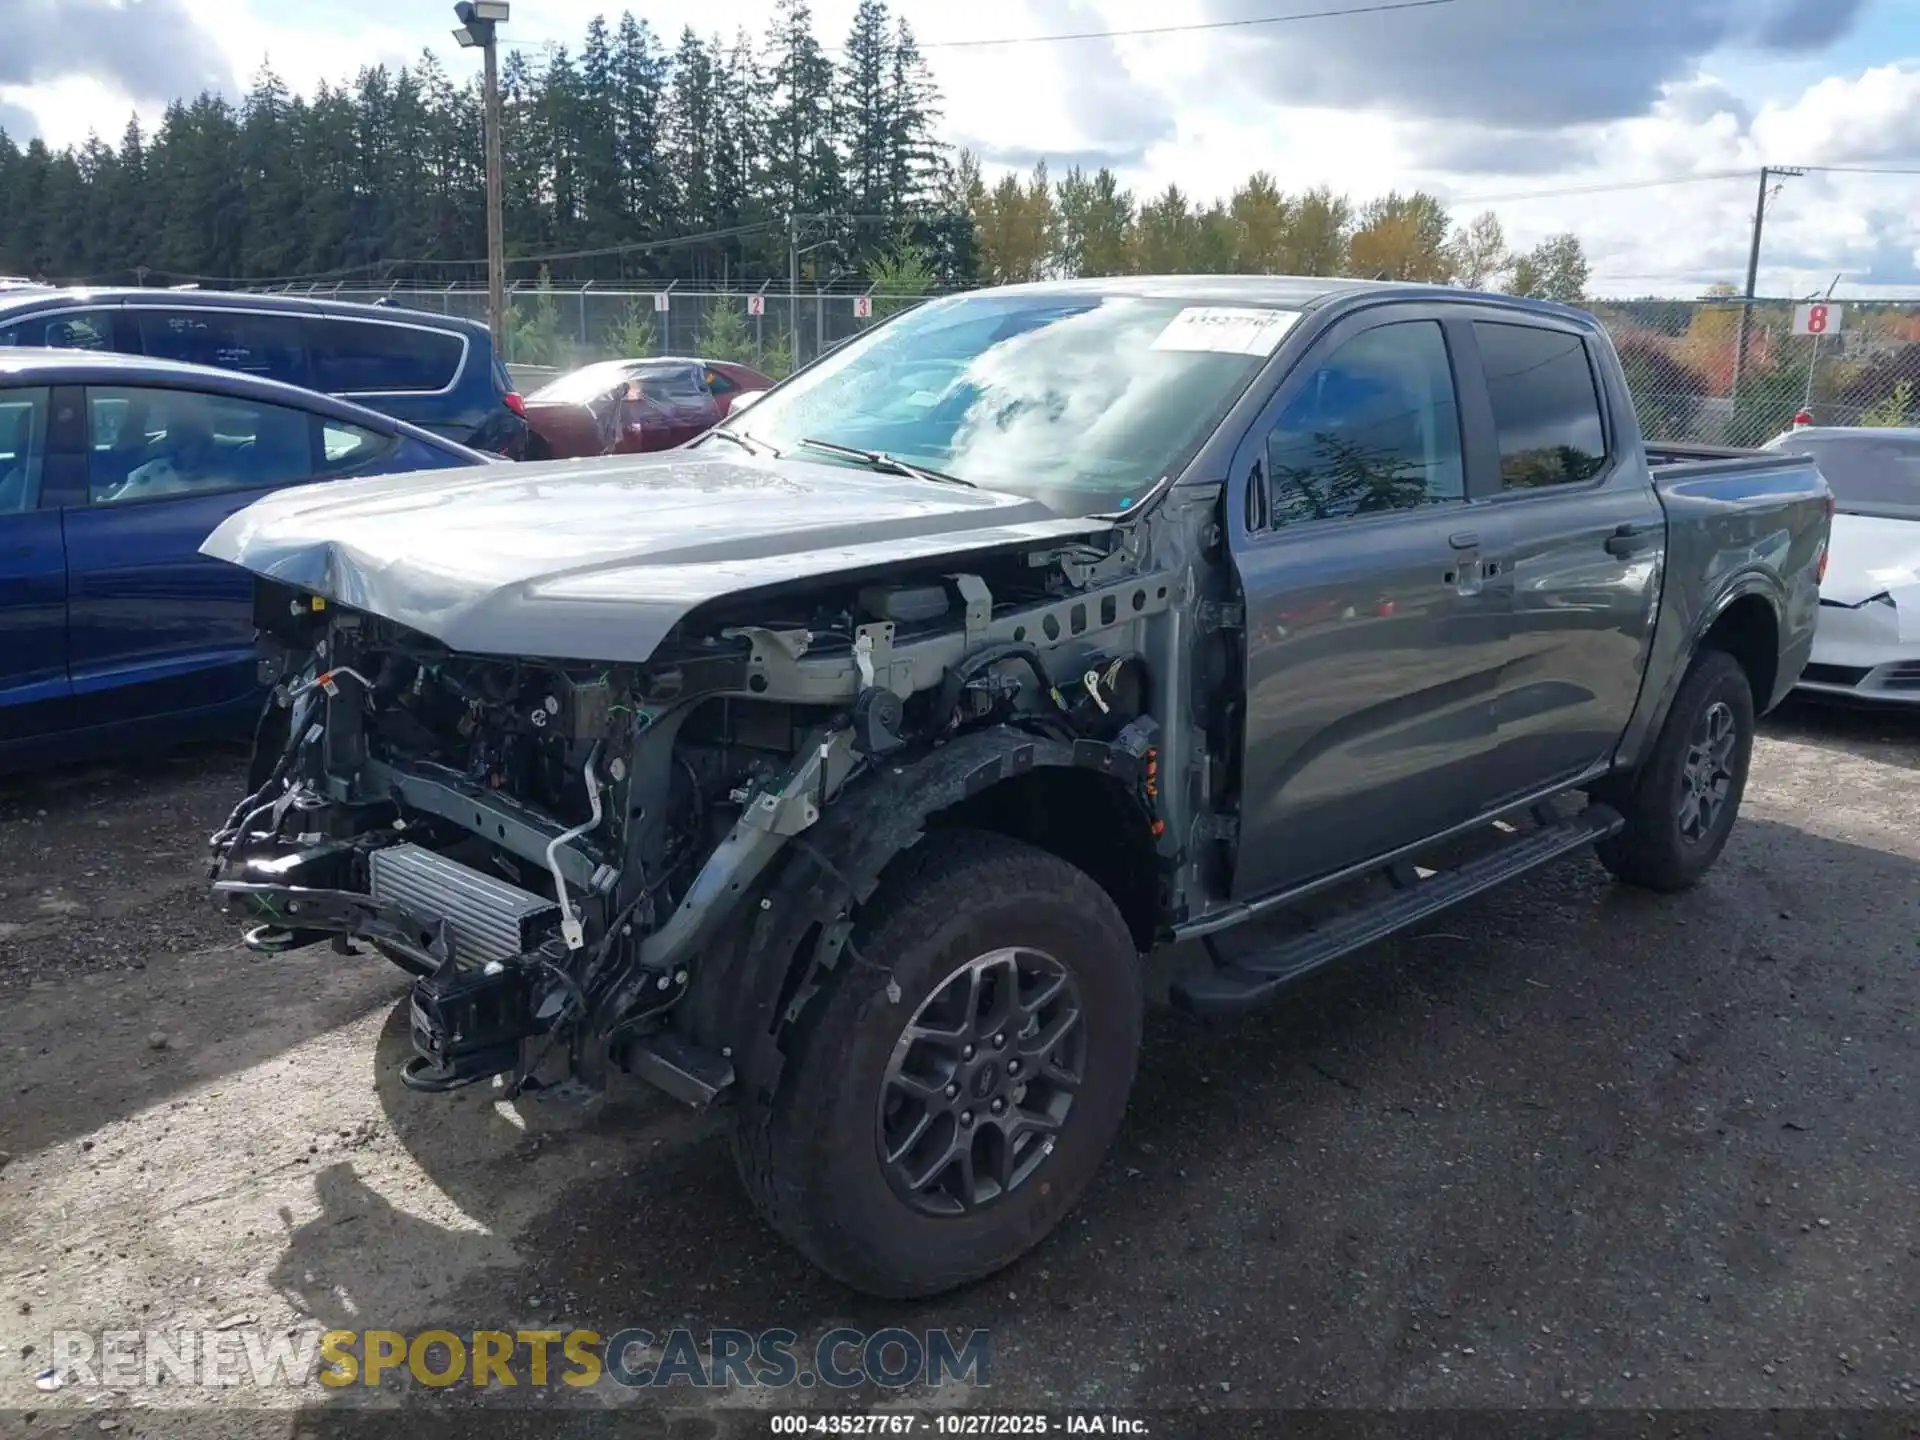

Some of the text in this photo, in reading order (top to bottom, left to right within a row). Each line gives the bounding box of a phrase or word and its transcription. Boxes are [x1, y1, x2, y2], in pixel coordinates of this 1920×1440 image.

[752, 298, 760, 314] 2
[859, 299, 867, 315] 3
[1808, 305, 1828, 332] 8
